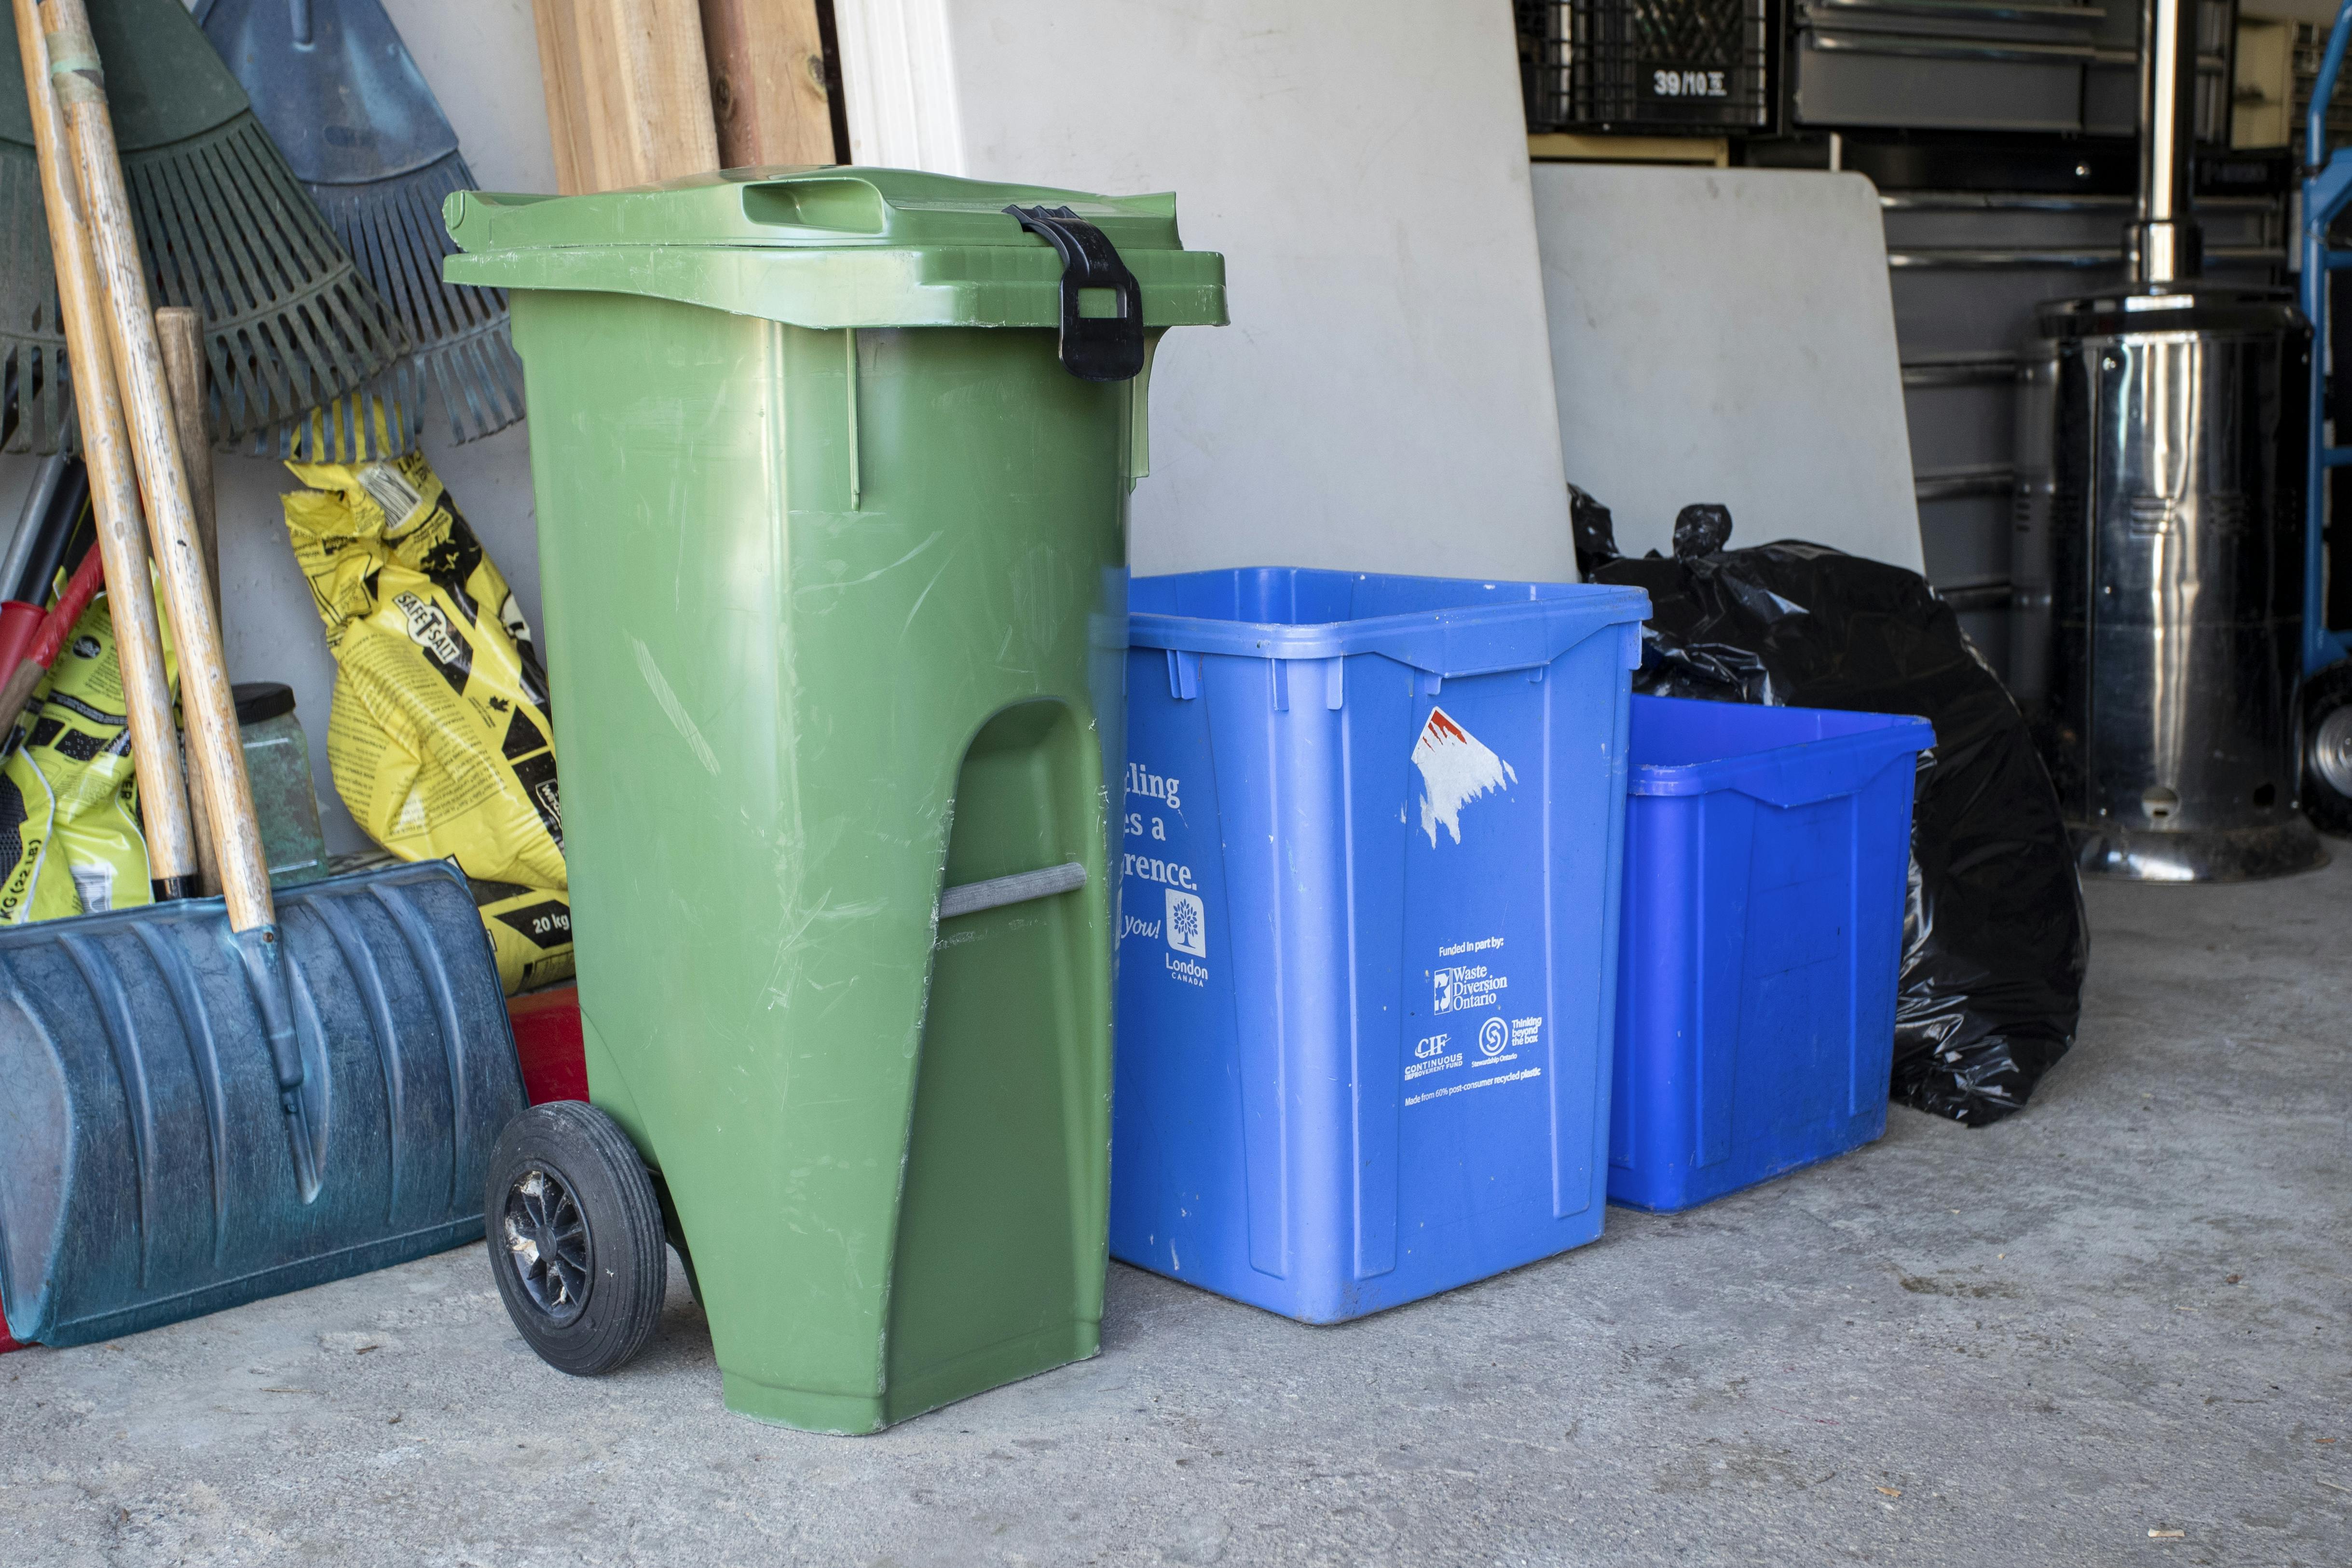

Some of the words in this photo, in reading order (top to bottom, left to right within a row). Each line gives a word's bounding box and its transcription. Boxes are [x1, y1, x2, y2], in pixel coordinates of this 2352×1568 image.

[1151, 817, 1166, 841] a
[1121, 853, 1197, 890] rence.
[533, 916, 550, 934] 20
[551, 914, 570, 931] kg
[1121, 915, 1161, 939] you!
[1439, 943, 1465, 957] Funded
[1475, 939, 1491, 953] part
[1491, 937, 1504, 949] by:
[1166, 952, 1208, 980] London
[1453, 965, 1487, 982] Waste
[1172, 972, 1203, 987] CANADA
[1453, 975, 1507, 996] Diversion
[1453, 991, 1496, 1010] Ontario
[1512, 1017, 1542, 1028] Thinking
[1512, 1025, 1538, 1037] beyond
[1415, 1033, 1451, 1059] CIF
[1512, 1036, 1523, 1046] the
[1524, 1035, 1538, 1044] box
[1405, 1052, 1463, 1075] CONTINUOUS
[1472, 1056, 1499, 1067] Stewardship
[1500, 1053, 1518, 1062] Ontario
[1405, 1064, 1445, 1081] IMPROVEMENT
[1446, 1061, 1463, 1069] FUND
[1405, 1095, 1420, 1106] Made
[1421, 1091, 1434, 1102] from
[1436, 1087, 1448, 1098] 60%
[1449, 1077, 1493, 1096] post-consumer
[1494, 1070, 1519, 1085] recycled
[1520, 1067, 1541, 1080] plastic
